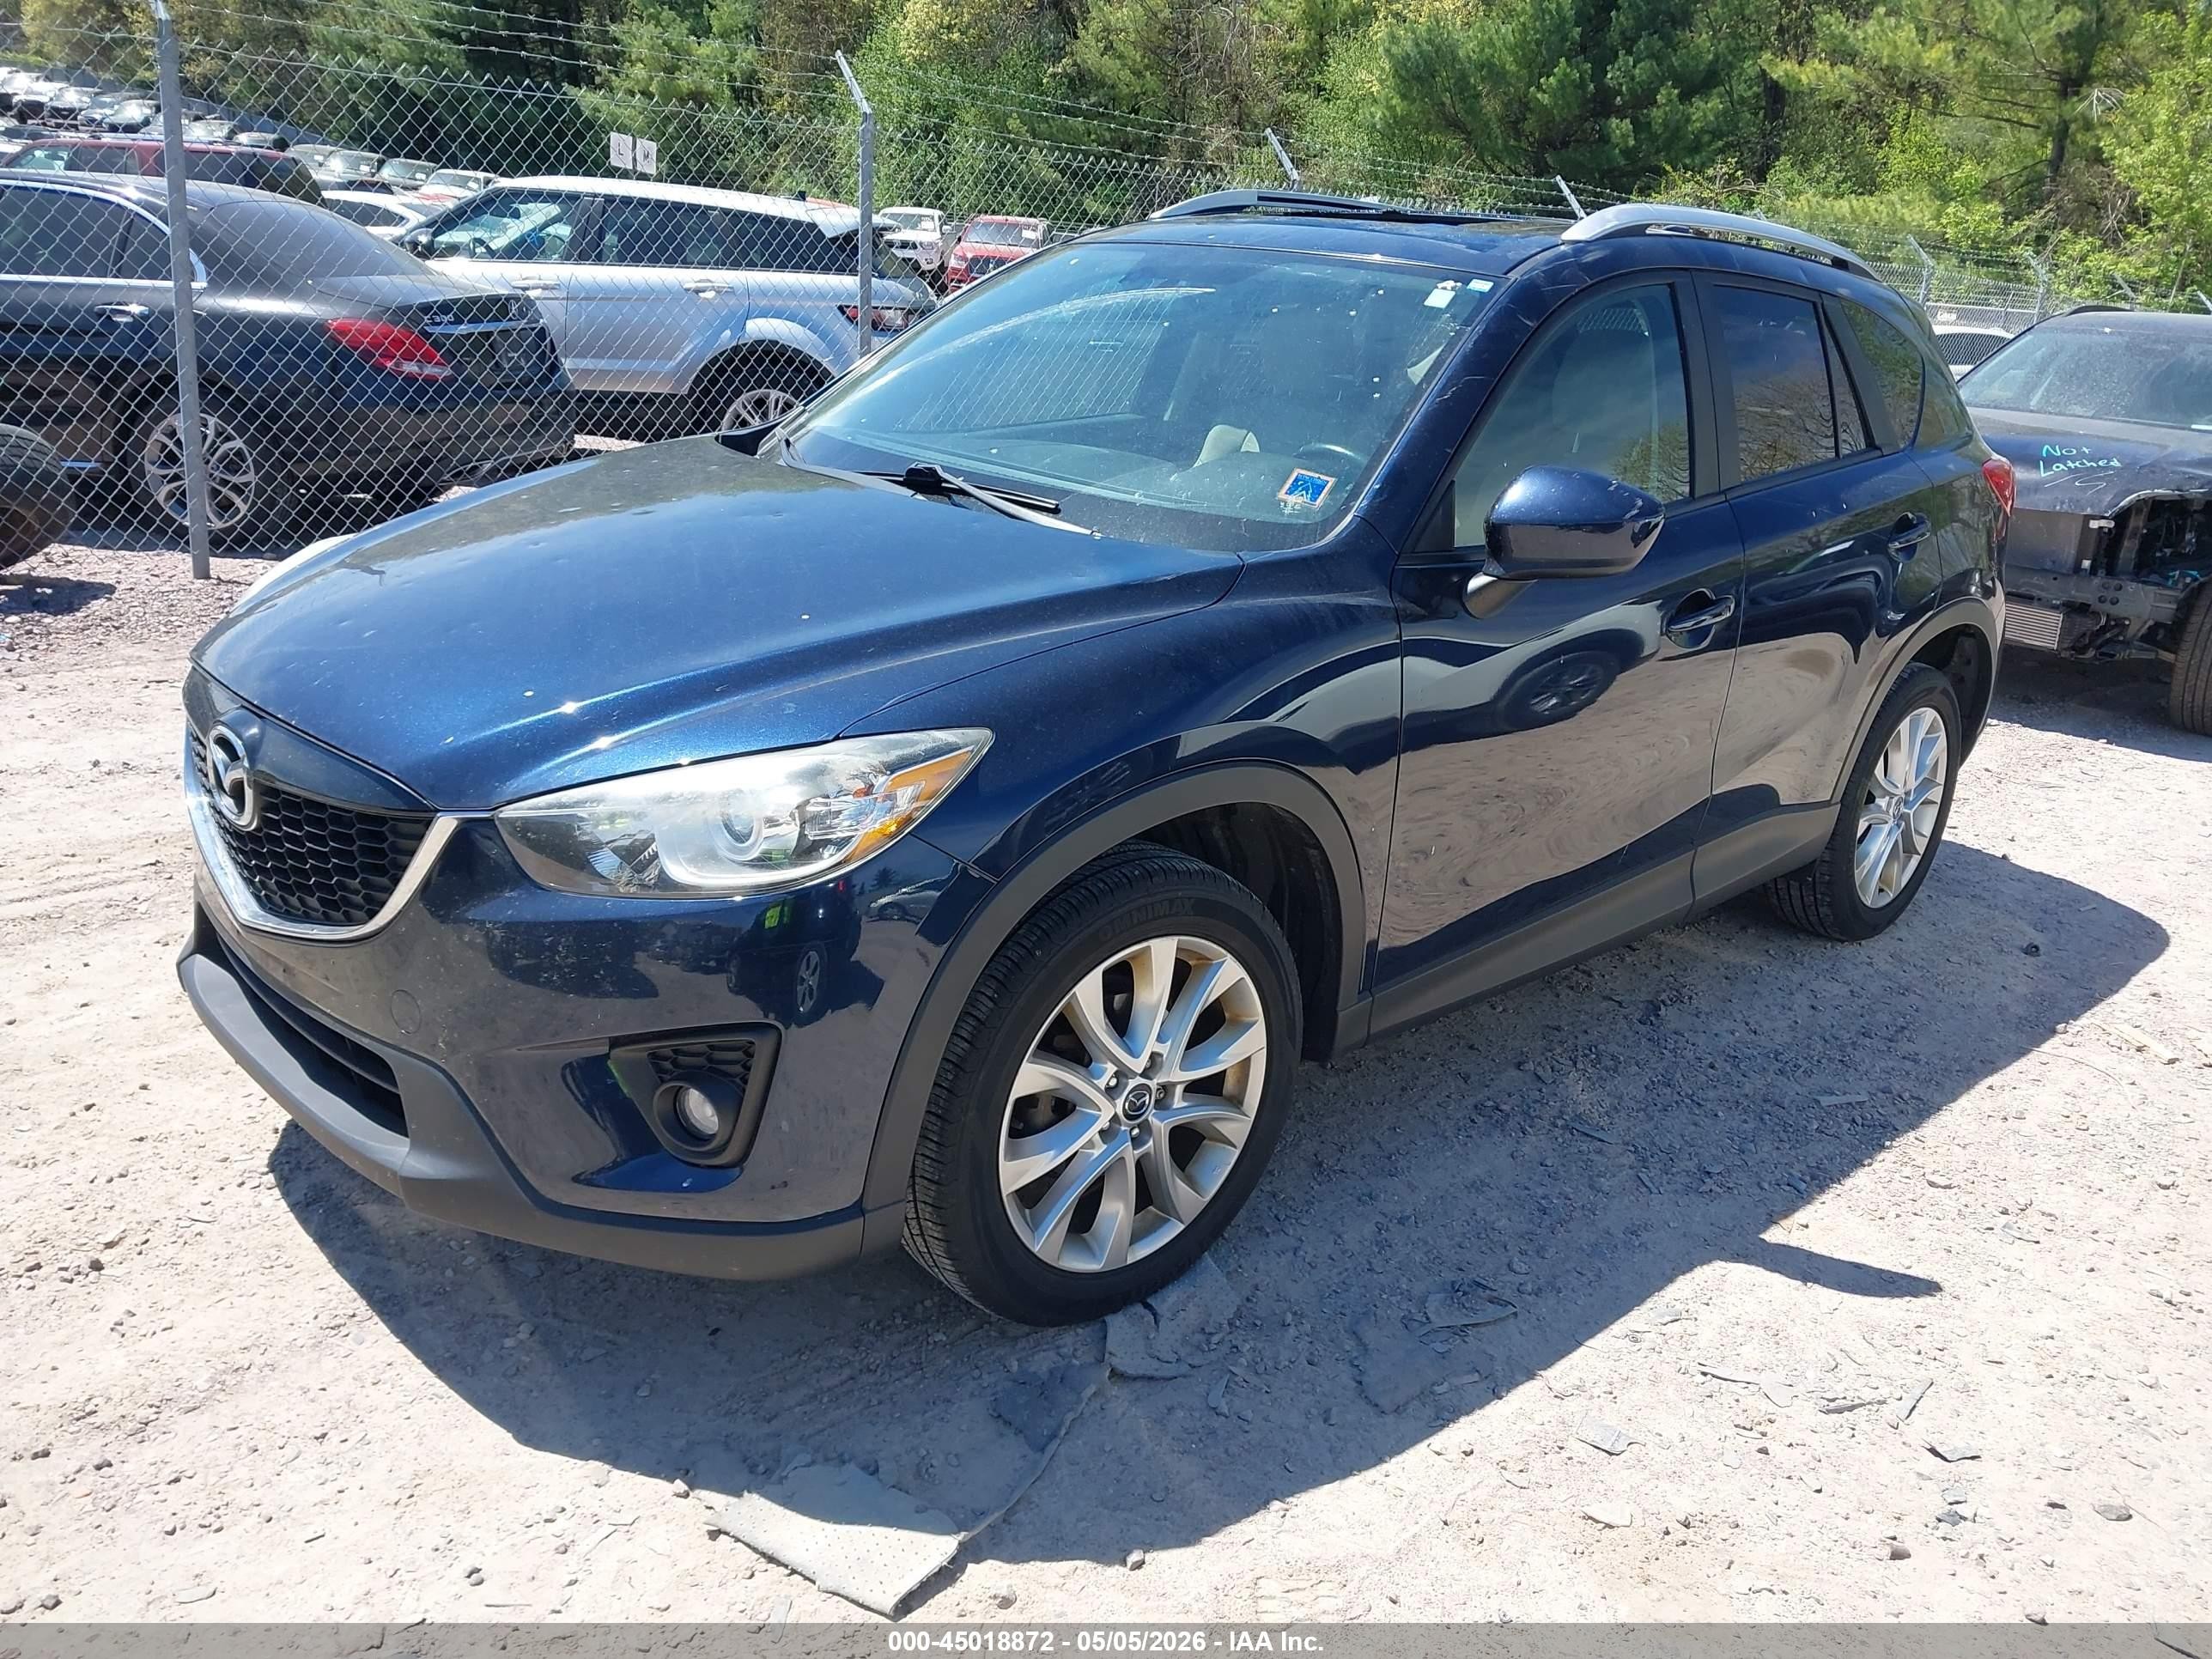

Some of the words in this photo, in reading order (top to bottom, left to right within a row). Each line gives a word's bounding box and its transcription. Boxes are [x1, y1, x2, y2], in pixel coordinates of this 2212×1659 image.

[2042, 444, 2092, 458] Not
[2039, 458, 2123, 477] Latched
[1099, 898, 1195, 942] OMNIMAX
